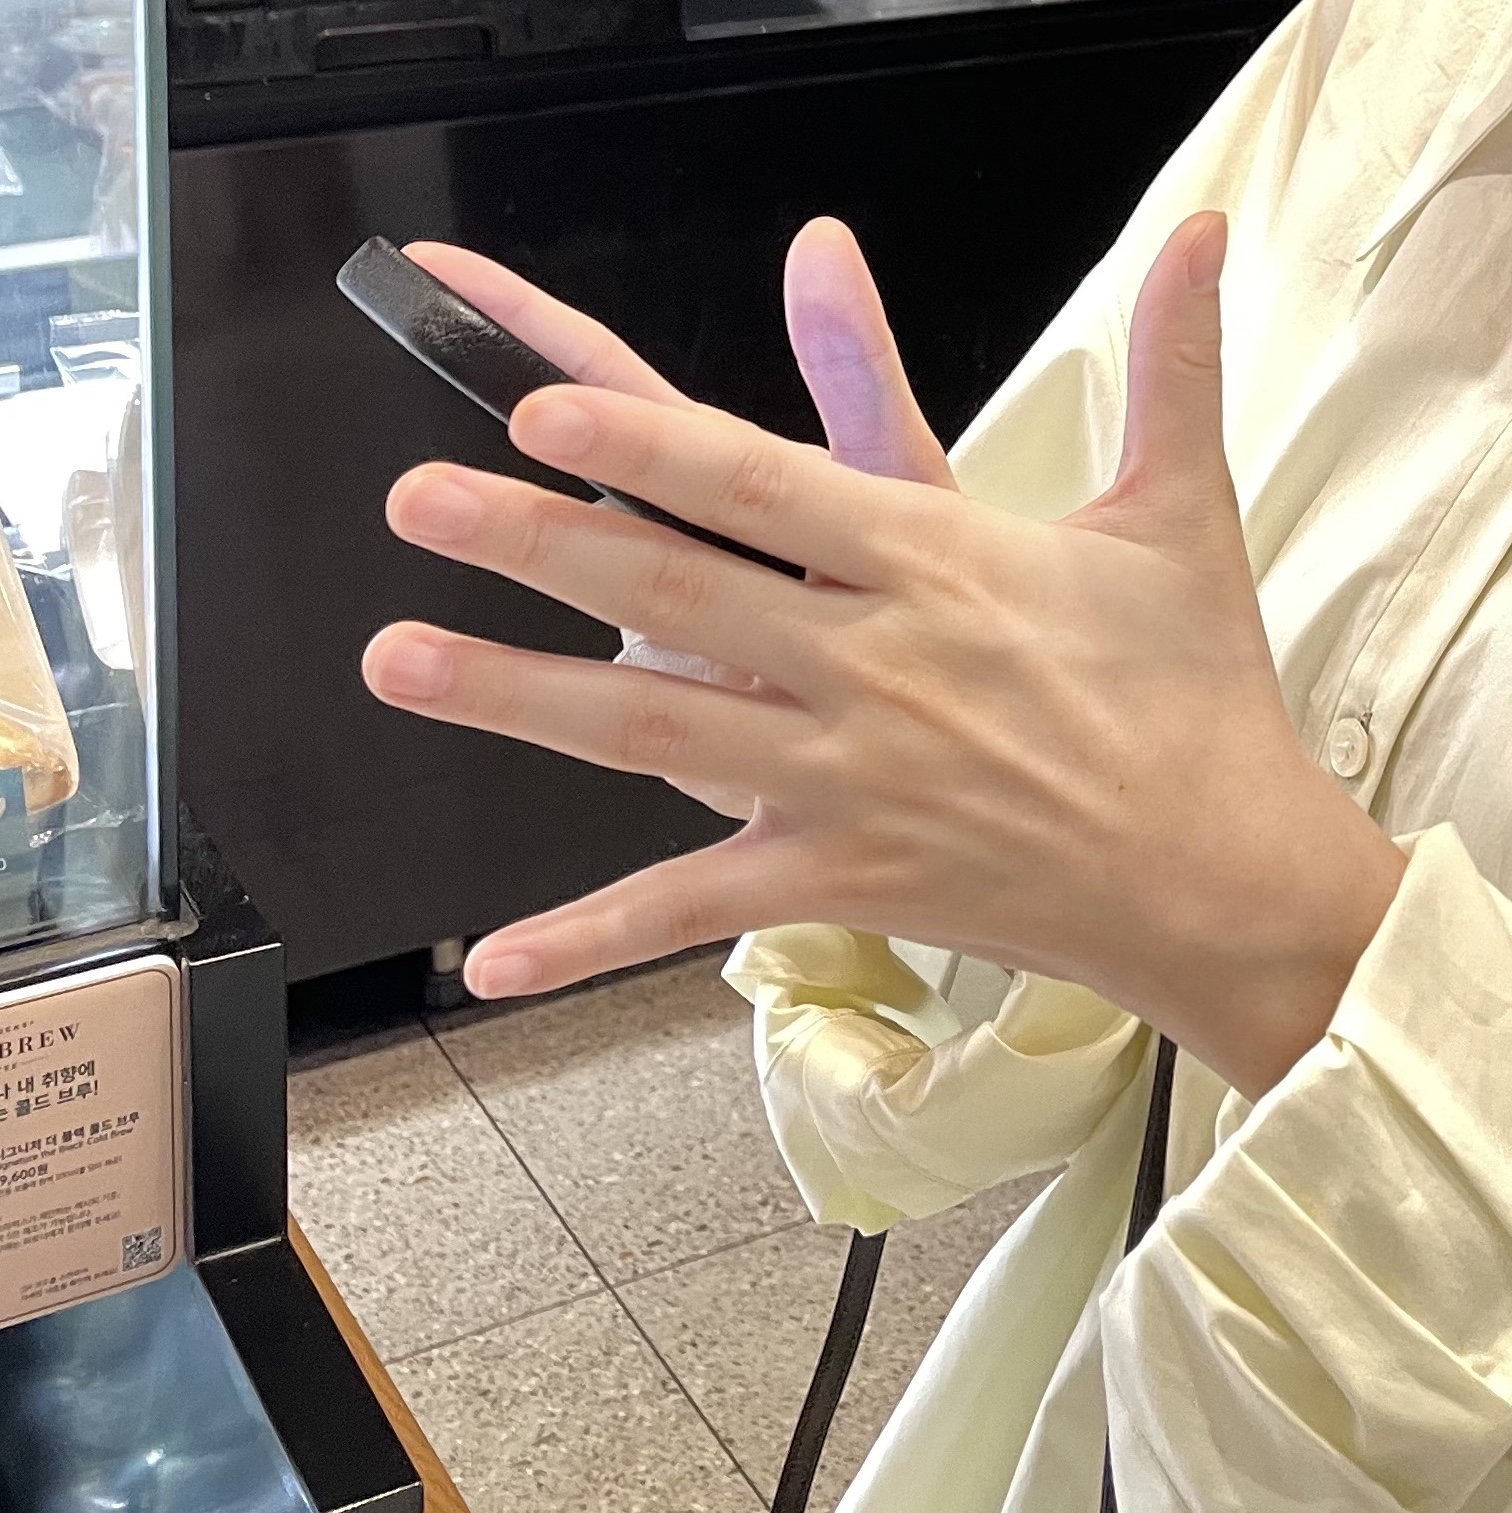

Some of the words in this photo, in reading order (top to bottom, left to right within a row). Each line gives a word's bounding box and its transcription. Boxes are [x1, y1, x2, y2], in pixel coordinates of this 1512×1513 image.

[0, 1022, 80, 1059] BREW
[17, 1076, 34, 1094] 내
[41, 1060, 95, 1089] 취향에
[56, 1079, 99, 1104] 브루!
